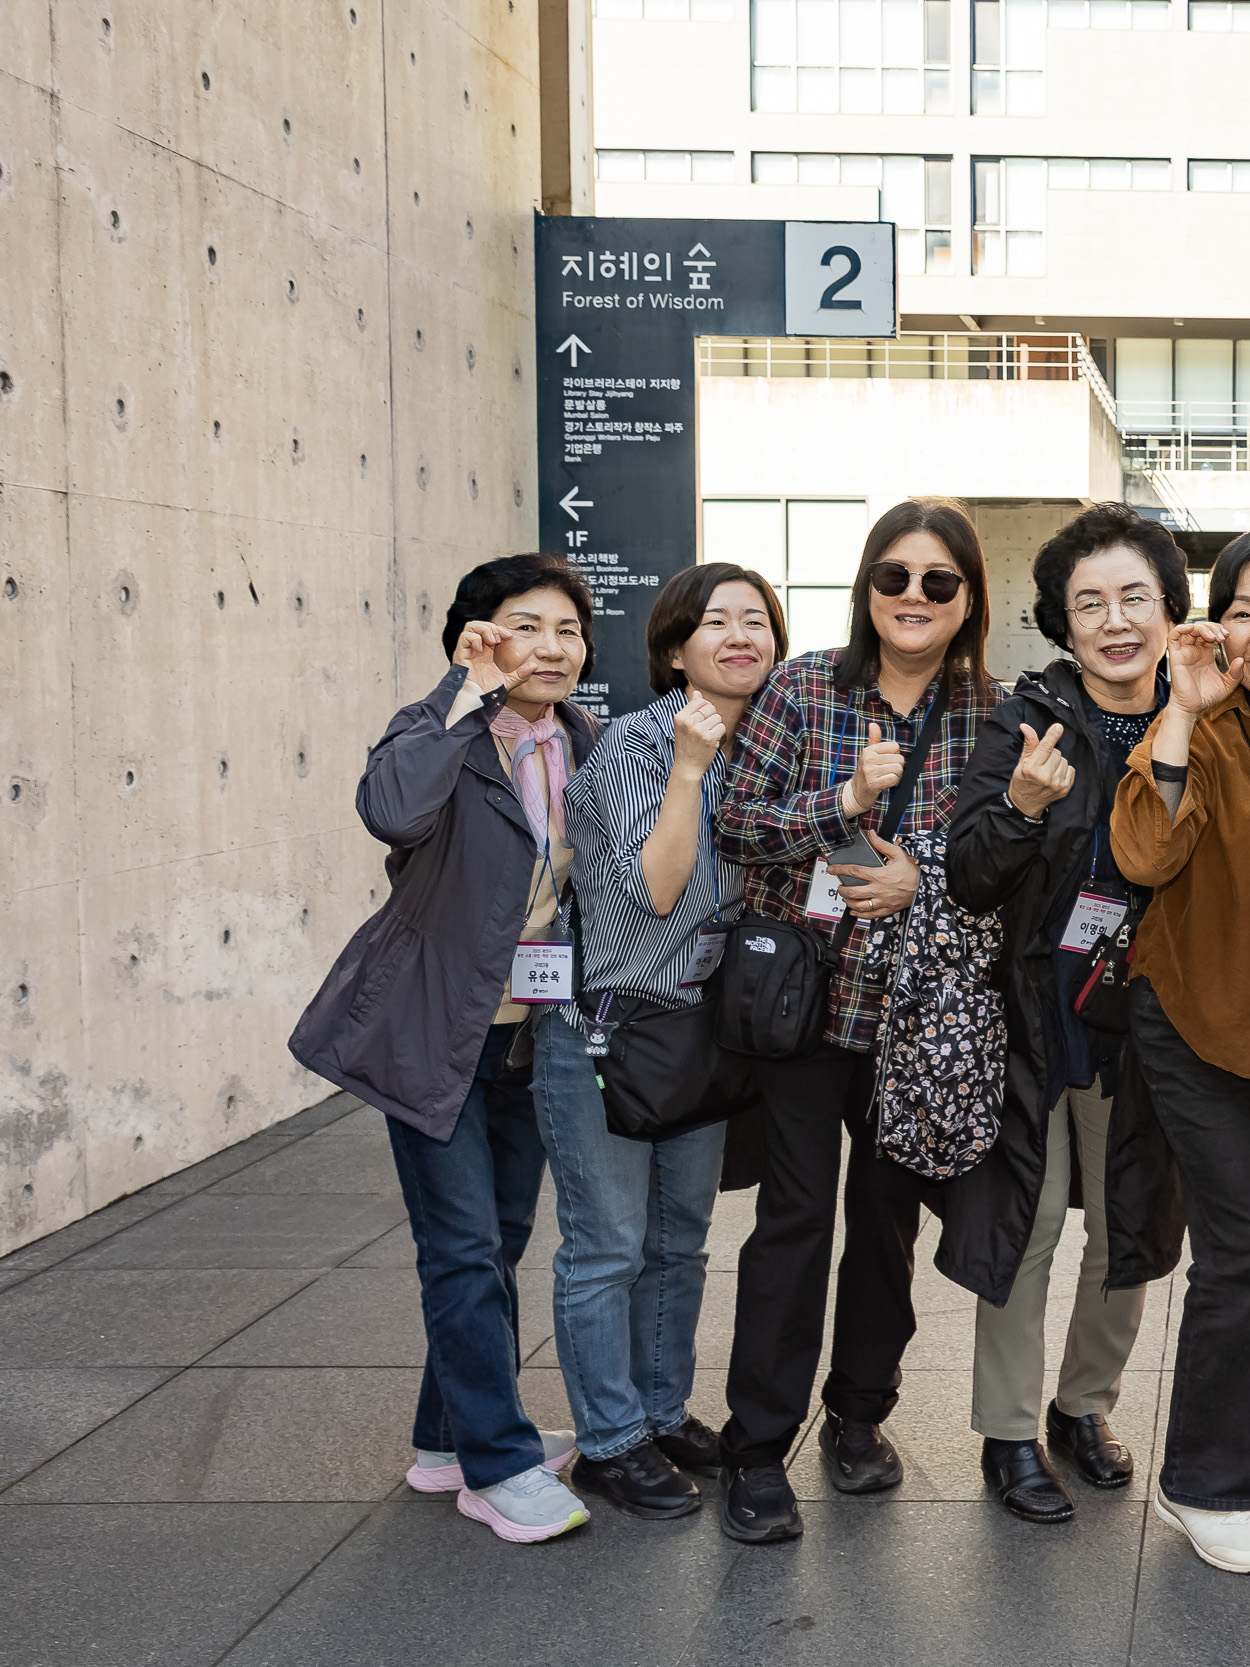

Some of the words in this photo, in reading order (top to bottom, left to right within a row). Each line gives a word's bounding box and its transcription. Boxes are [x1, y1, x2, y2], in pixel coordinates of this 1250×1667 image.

[562, 250, 672, 282] 지혜의
[682, 242, 717, 290] 숲
[820, 245, 862, 309] 2
[562, 291, 620, 309] Forest
[626, 293, 644, 308] of
[650, 293, 724, 310] Wisdom
[562, 377, 646, 390] 라이브러리스테이
[649, 378, 681, 390] 지지향
[563, 390, 586, 398] Library
[588, 390, 604, 398] Stay
[564, 399, 607, 410] 문발살롱
[564, 422, 584, 432] 경기
[585, 422, 632, 432] 스토리작가
[634, 422, 662, 433] 창작소
[664, 423, 684, 433] 파주
[564, 443, 602, 454] 기업은행
[566, 531, 588, 547] 1F
[596, 587, 619, 595] Library
[528, 970, 560, 983] 유순옥
